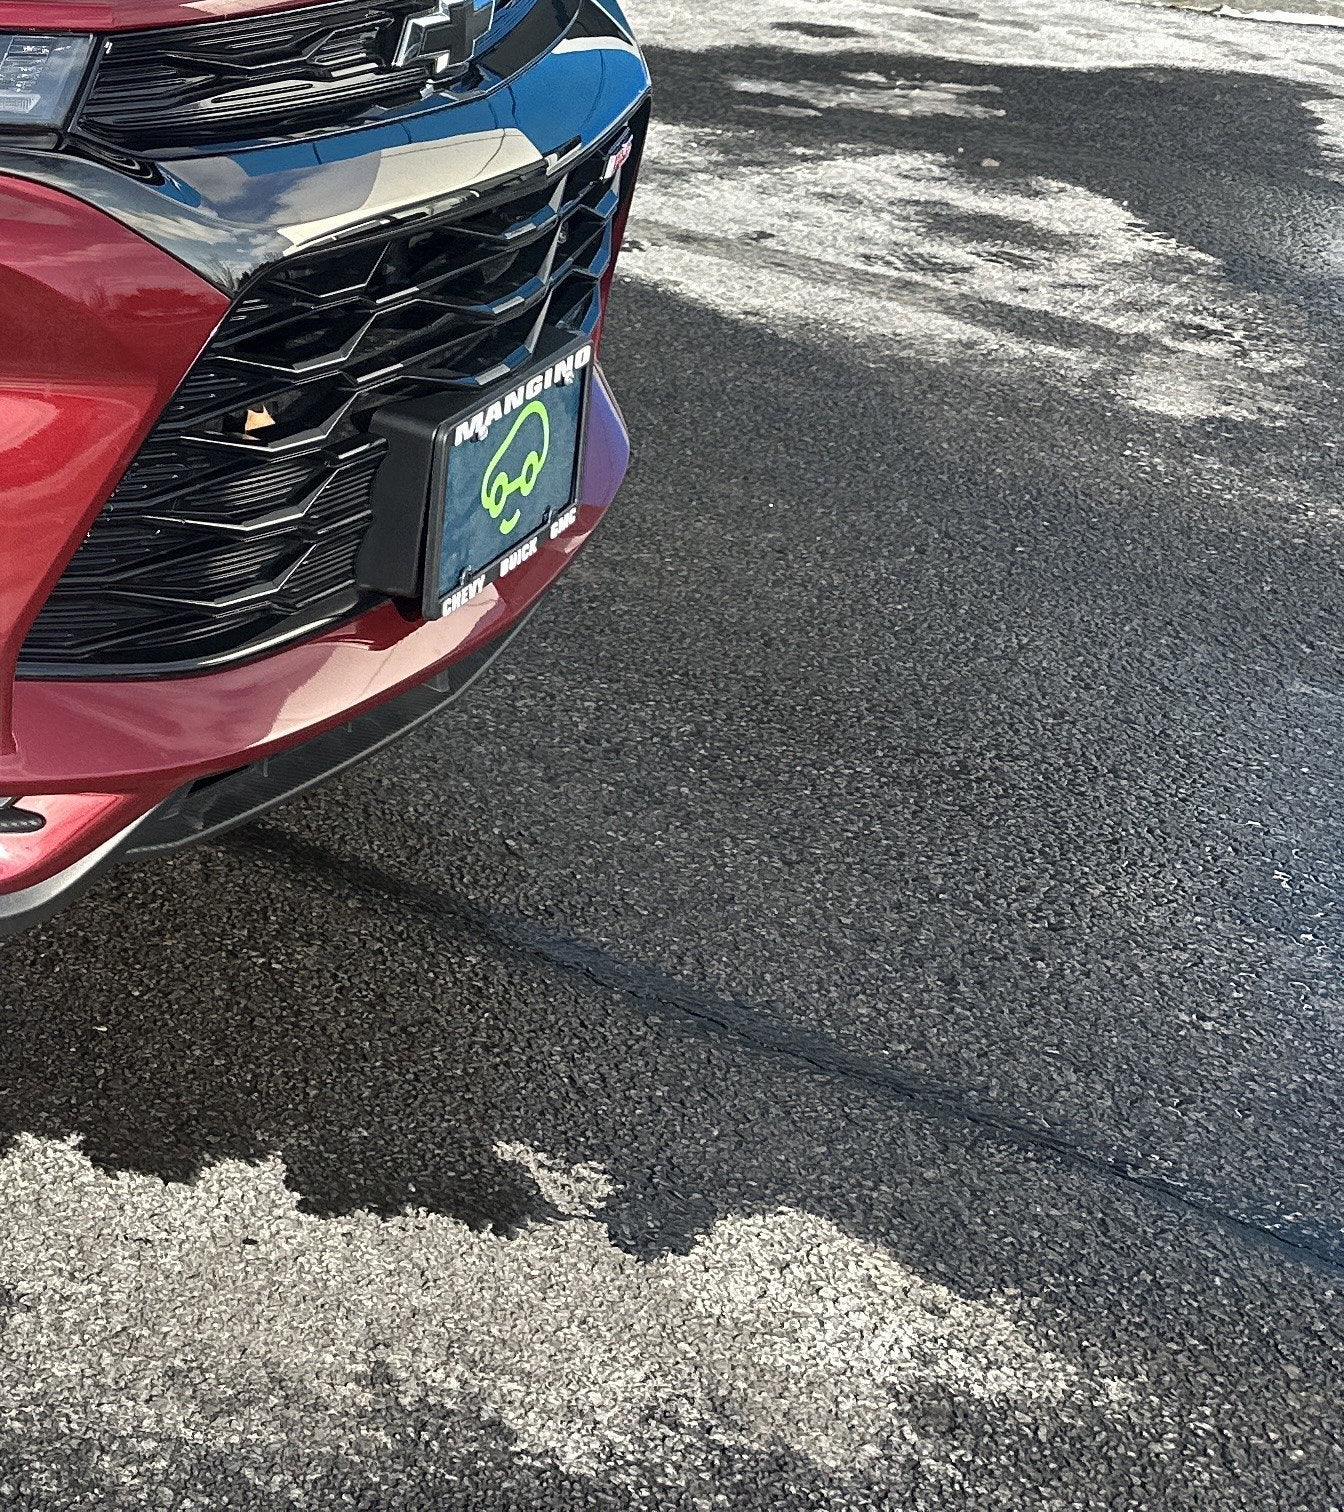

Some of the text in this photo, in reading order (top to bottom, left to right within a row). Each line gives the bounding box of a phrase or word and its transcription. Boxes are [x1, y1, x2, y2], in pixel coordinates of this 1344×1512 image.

[454, 344, 592, 447] MANGINO
[442, 507, 577, 617] CHEVY BUICK GMC
